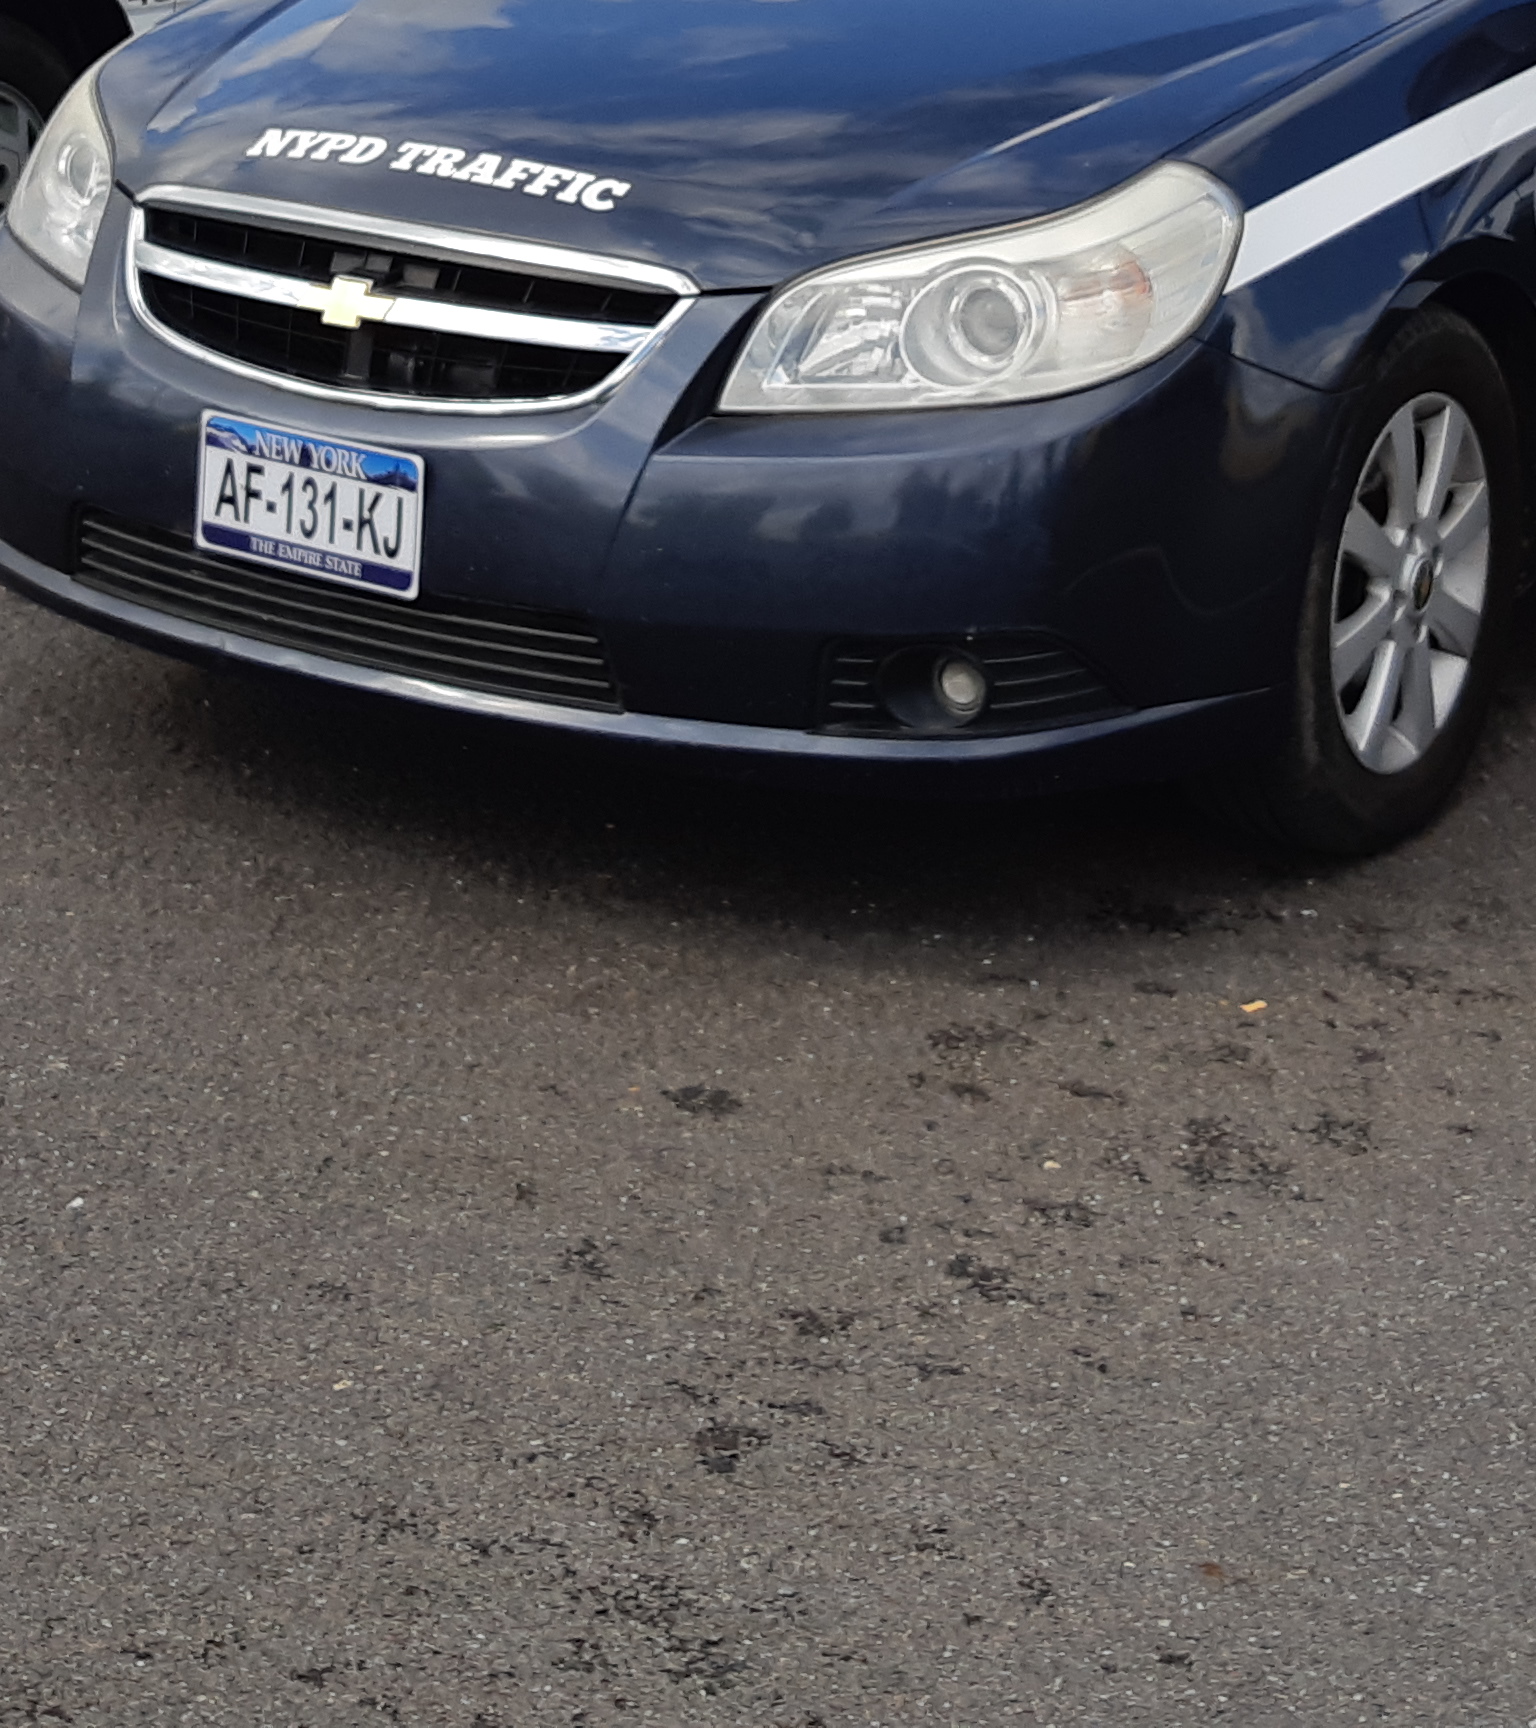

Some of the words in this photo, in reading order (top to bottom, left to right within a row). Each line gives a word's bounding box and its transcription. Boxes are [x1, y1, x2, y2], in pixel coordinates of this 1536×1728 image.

[245, 127, 388, 165] NYPD
[389, 141, 632, 212] TRAFFIC
[253, 430, 306, 465] NEW
[308, 442, 368, 480] YORK
[215, 457, 403, 559] AF-131-KJ
[249, 536, 276, 554] THE
[278, 541, 324, 567] EMPIRE
[325, 555, 363, 578] STATE
